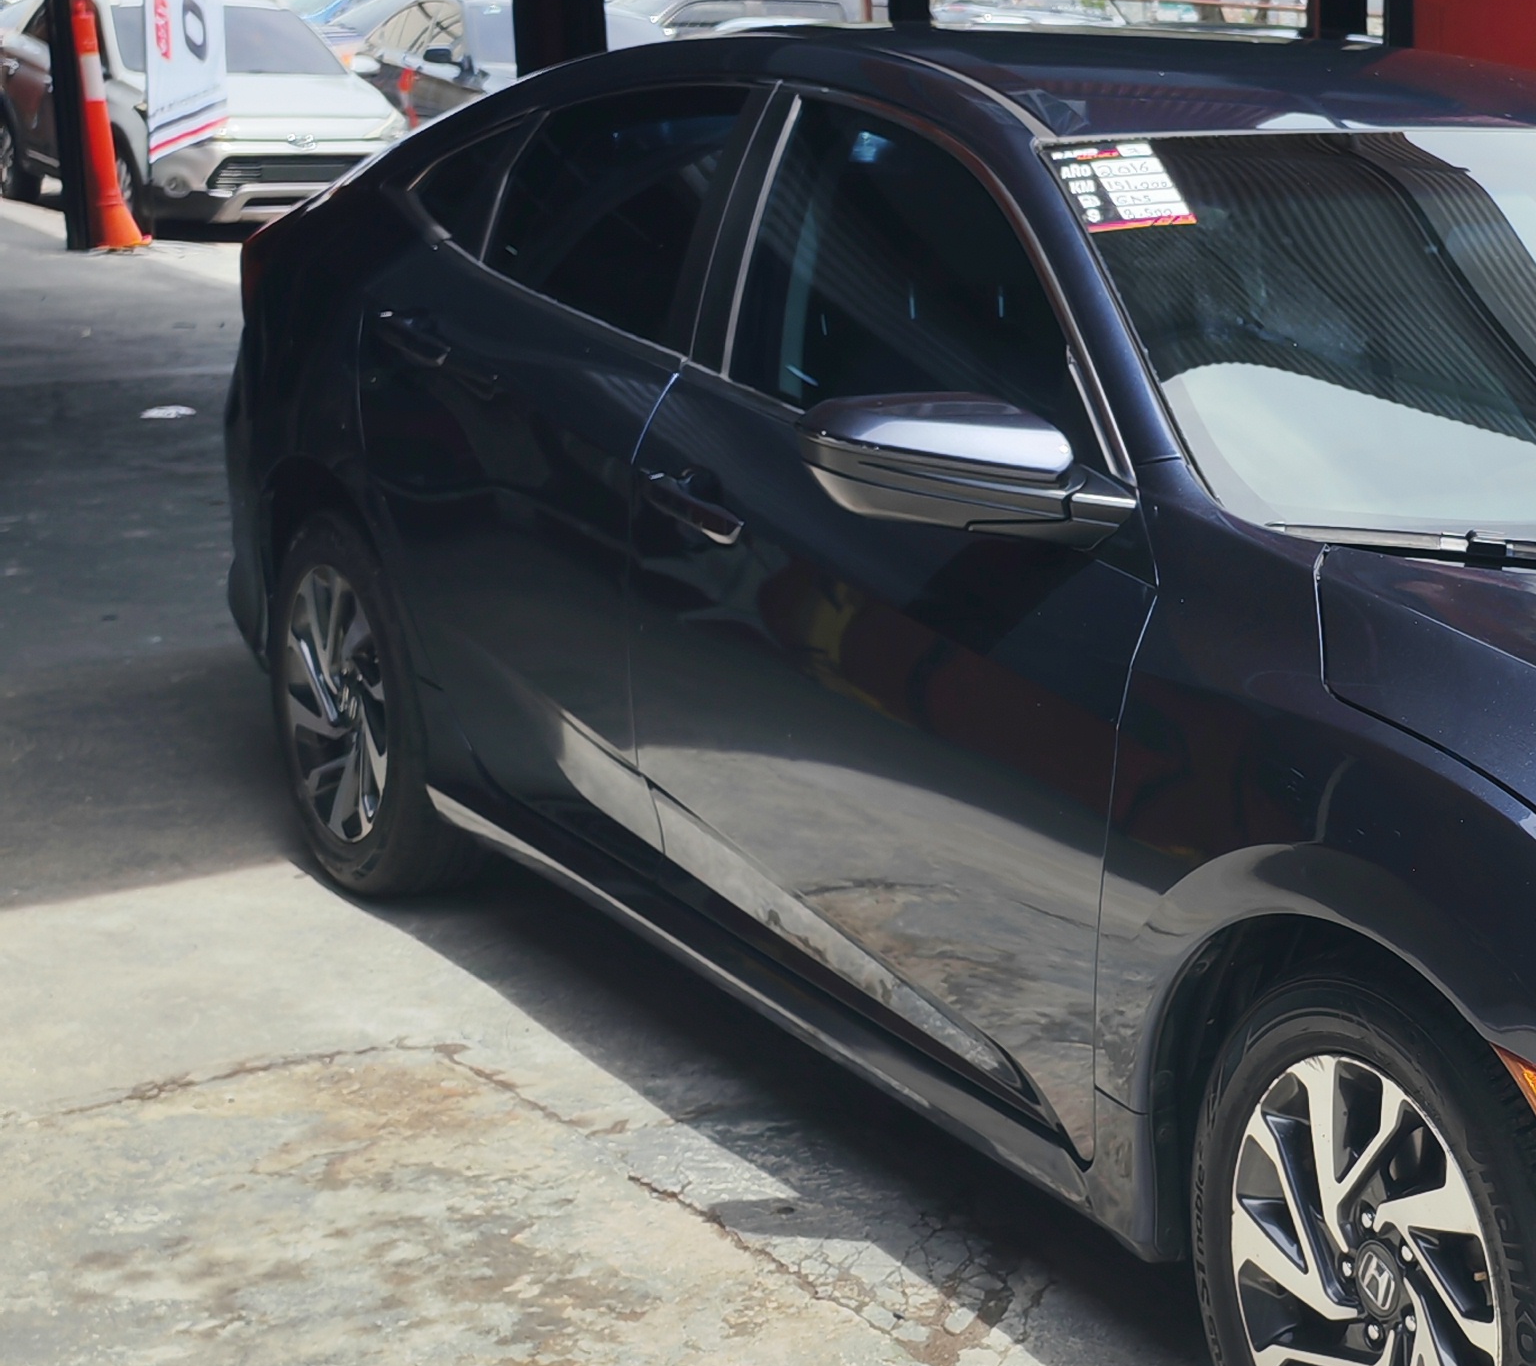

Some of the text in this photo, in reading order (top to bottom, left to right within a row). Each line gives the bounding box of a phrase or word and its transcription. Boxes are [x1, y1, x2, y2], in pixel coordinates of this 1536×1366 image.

[1060, 161, 1149, 179] AÑO 2016
[1068, 180, 1096, 195] KM
